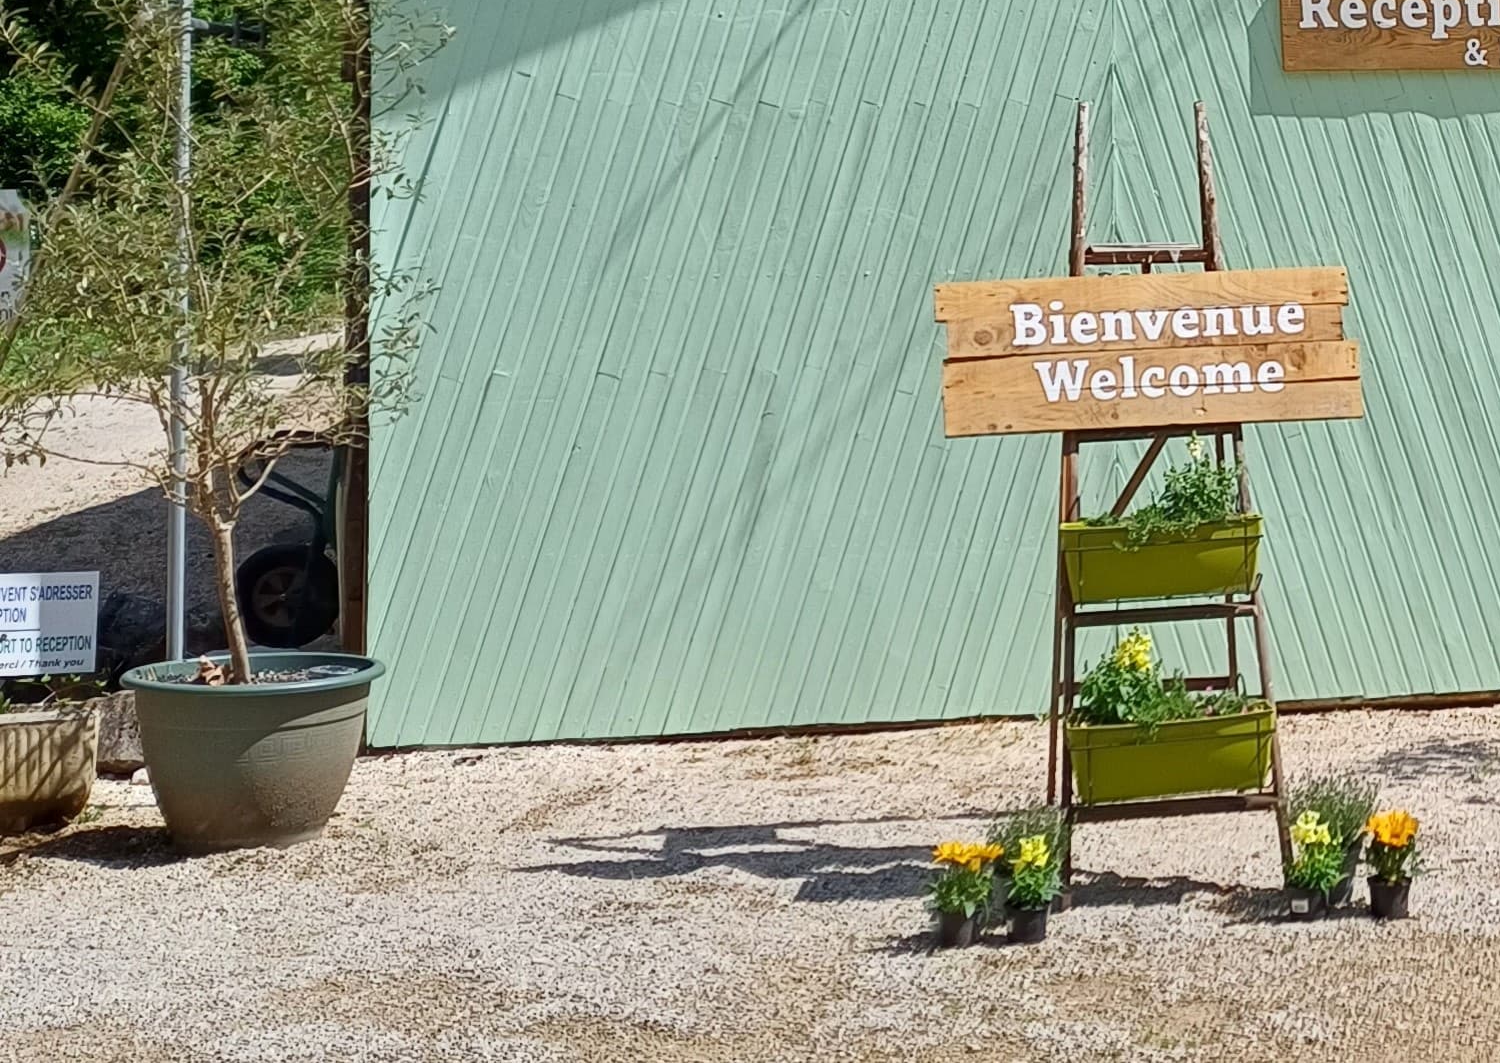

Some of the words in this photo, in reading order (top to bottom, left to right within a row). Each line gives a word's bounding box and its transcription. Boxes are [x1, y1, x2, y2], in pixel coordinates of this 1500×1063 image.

[1464, 38, 1489, 66] &
[1008, 300, 1306, 346] Bienvenue
[1032, 356, 1286, 403] Welcome
[30, 585, 92, 601] S'ADRESSER
[20, 638, 32, 653] TO
[36, 635, 91, 653] RECEPTION
[29, 658, 61, 668] Thank
[63, 659, 84, 668] you
